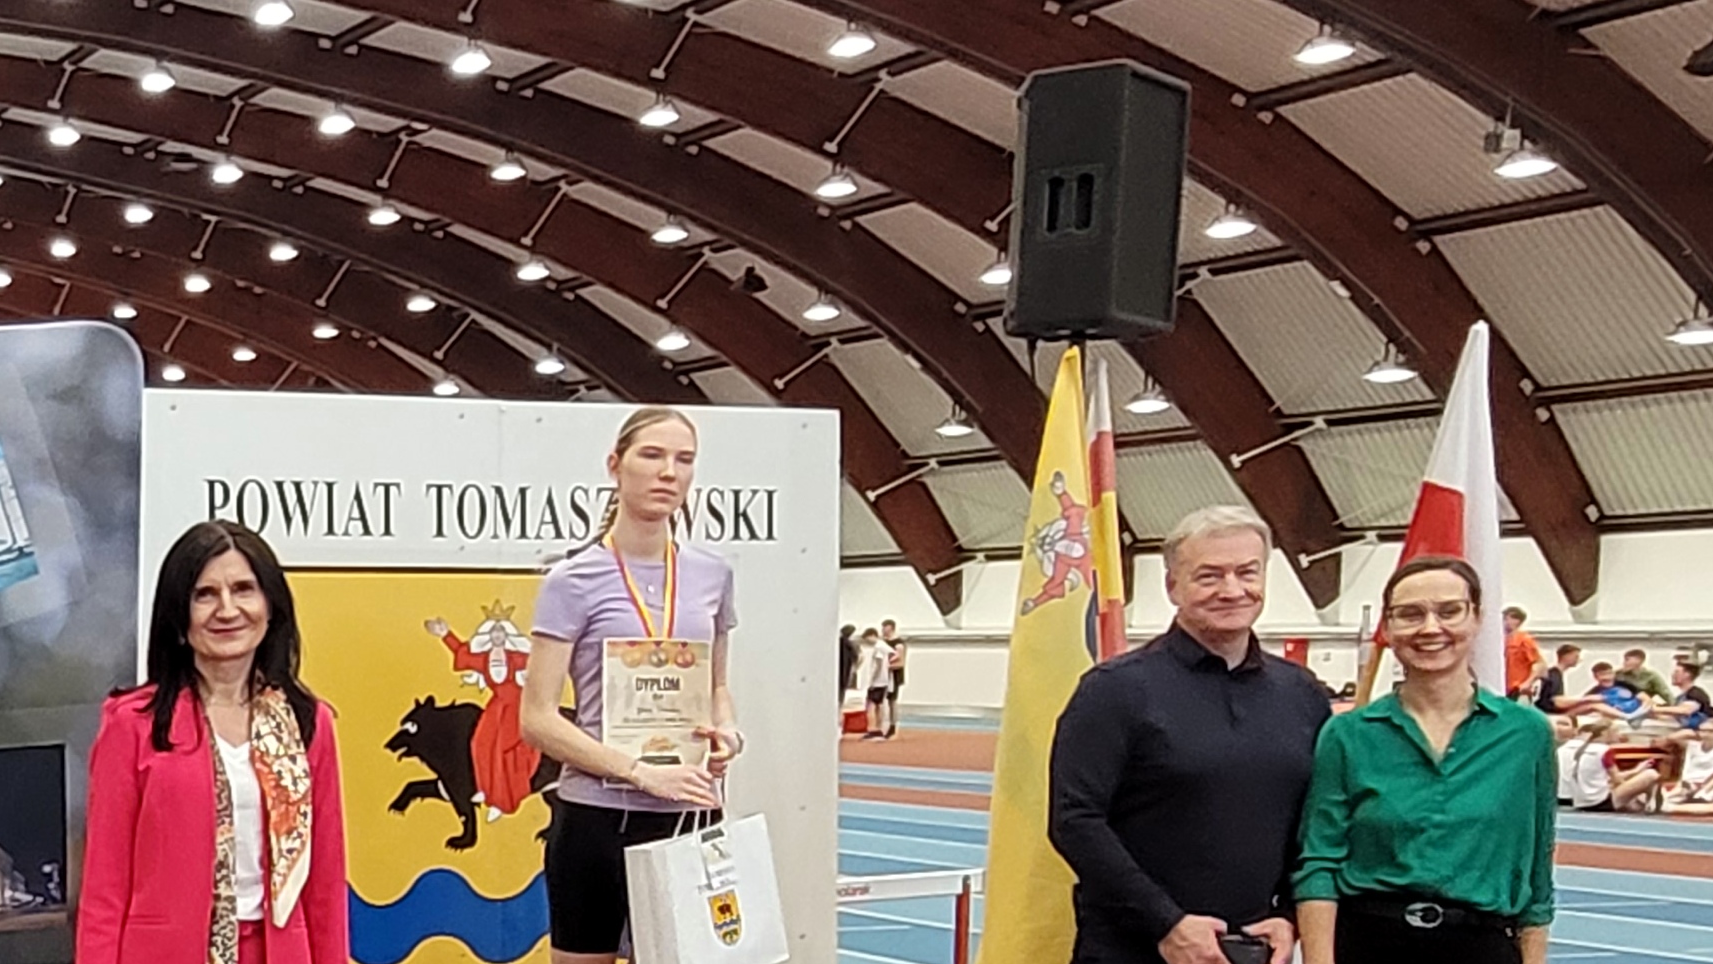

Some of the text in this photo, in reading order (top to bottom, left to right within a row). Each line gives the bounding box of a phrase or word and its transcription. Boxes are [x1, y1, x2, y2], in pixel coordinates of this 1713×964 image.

[203, 478, 778, 542] POWIAT TOMASZWSKI
[635, 676, 681, 691] DYPLOM
